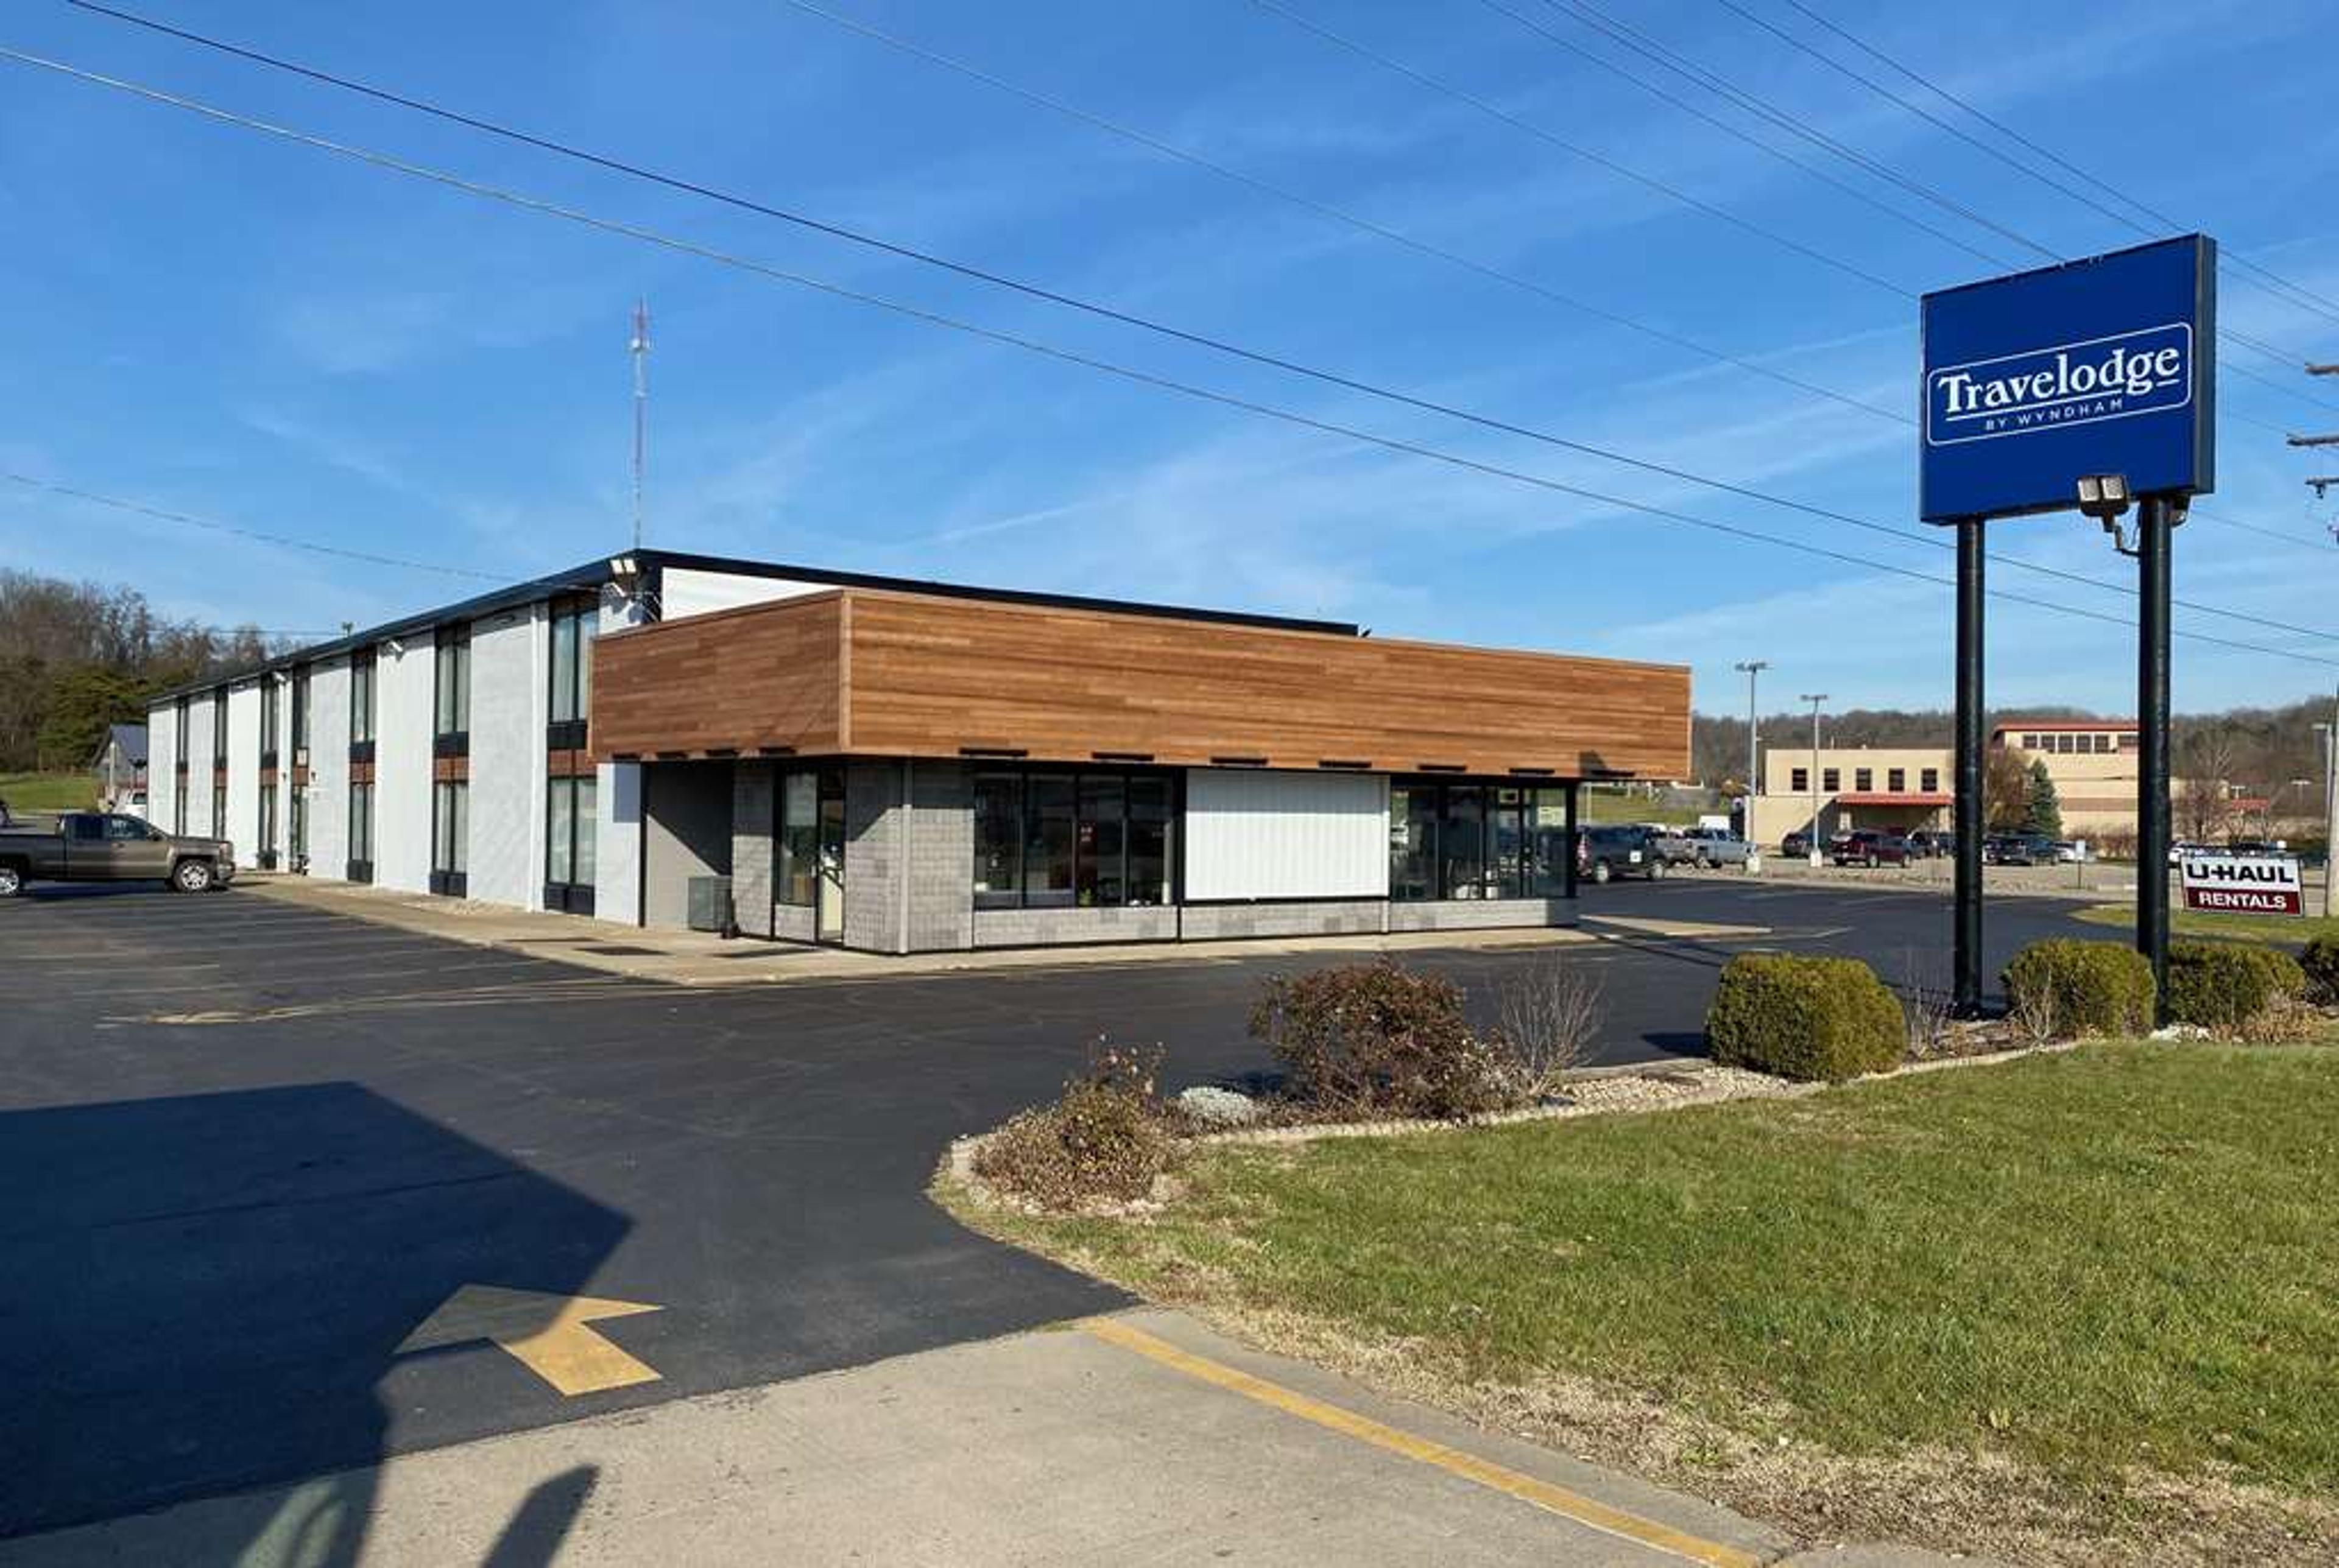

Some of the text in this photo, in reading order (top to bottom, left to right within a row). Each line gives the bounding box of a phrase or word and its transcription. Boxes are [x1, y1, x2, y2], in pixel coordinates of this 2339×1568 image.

[1938, 346, 2180, 413] Travelodge
[1986, 398, 2123, 430] BY WYNDHAM
[2186, 863, 2294, 882] U-HAUL
[2199, 891, 2287, 909] RENTALS
